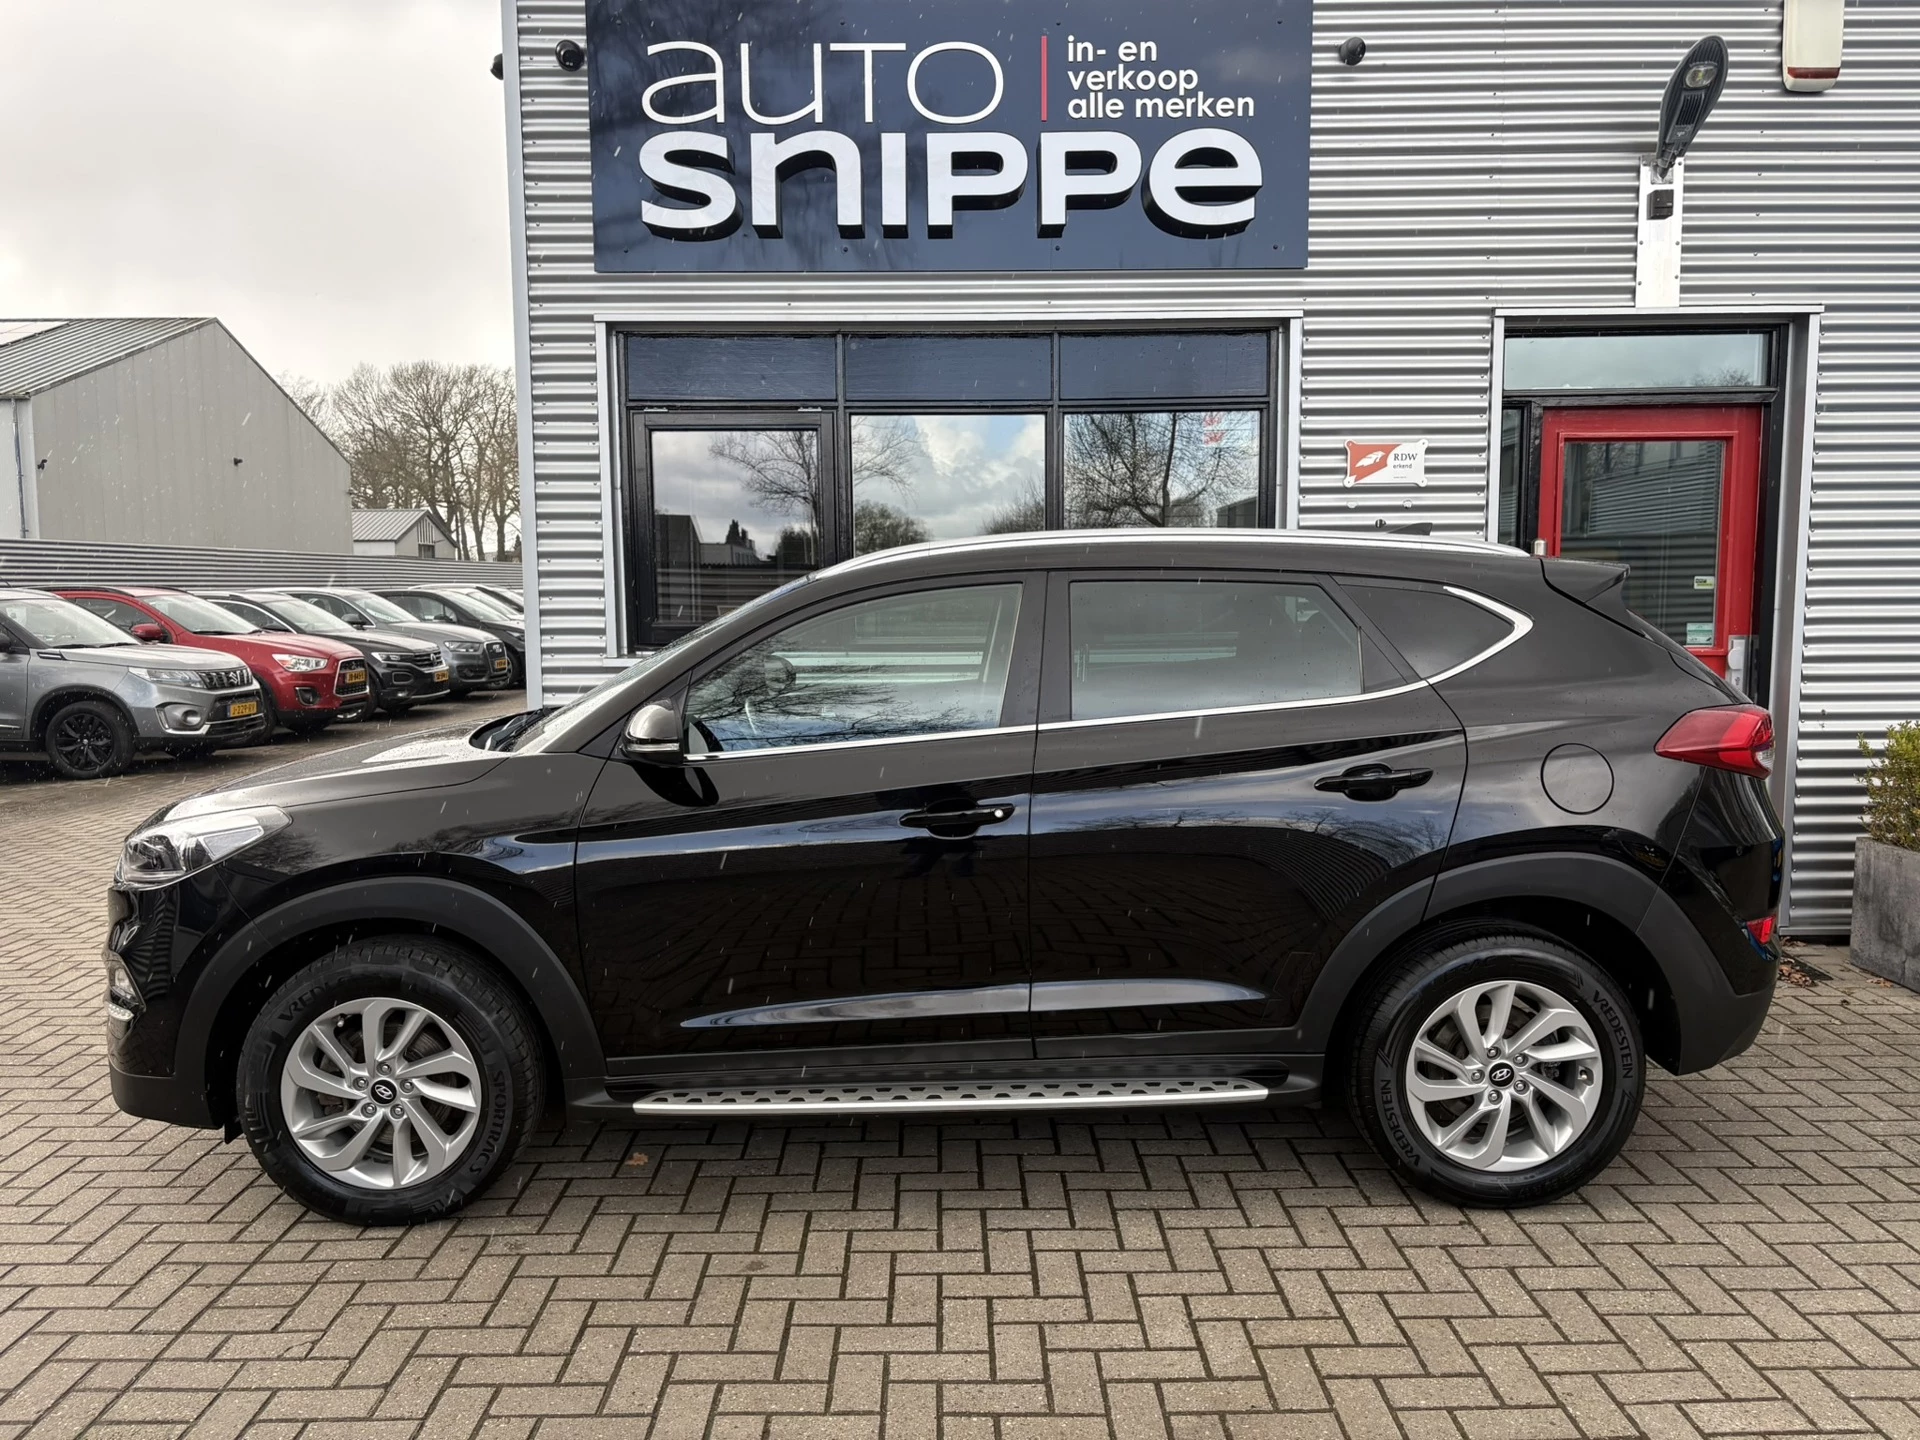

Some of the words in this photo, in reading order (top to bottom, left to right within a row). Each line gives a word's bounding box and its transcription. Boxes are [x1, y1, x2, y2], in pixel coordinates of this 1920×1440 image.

[1067, 35, 1107, 62] in-
[1118, 40, 1158, 62] en
[1067, 64, 1199, 96] verkoop
[1067, 92, 1125, 119] alle
[1135, 91, 1255, 118] merken
[1393, 453, 1418, 461] RDW
